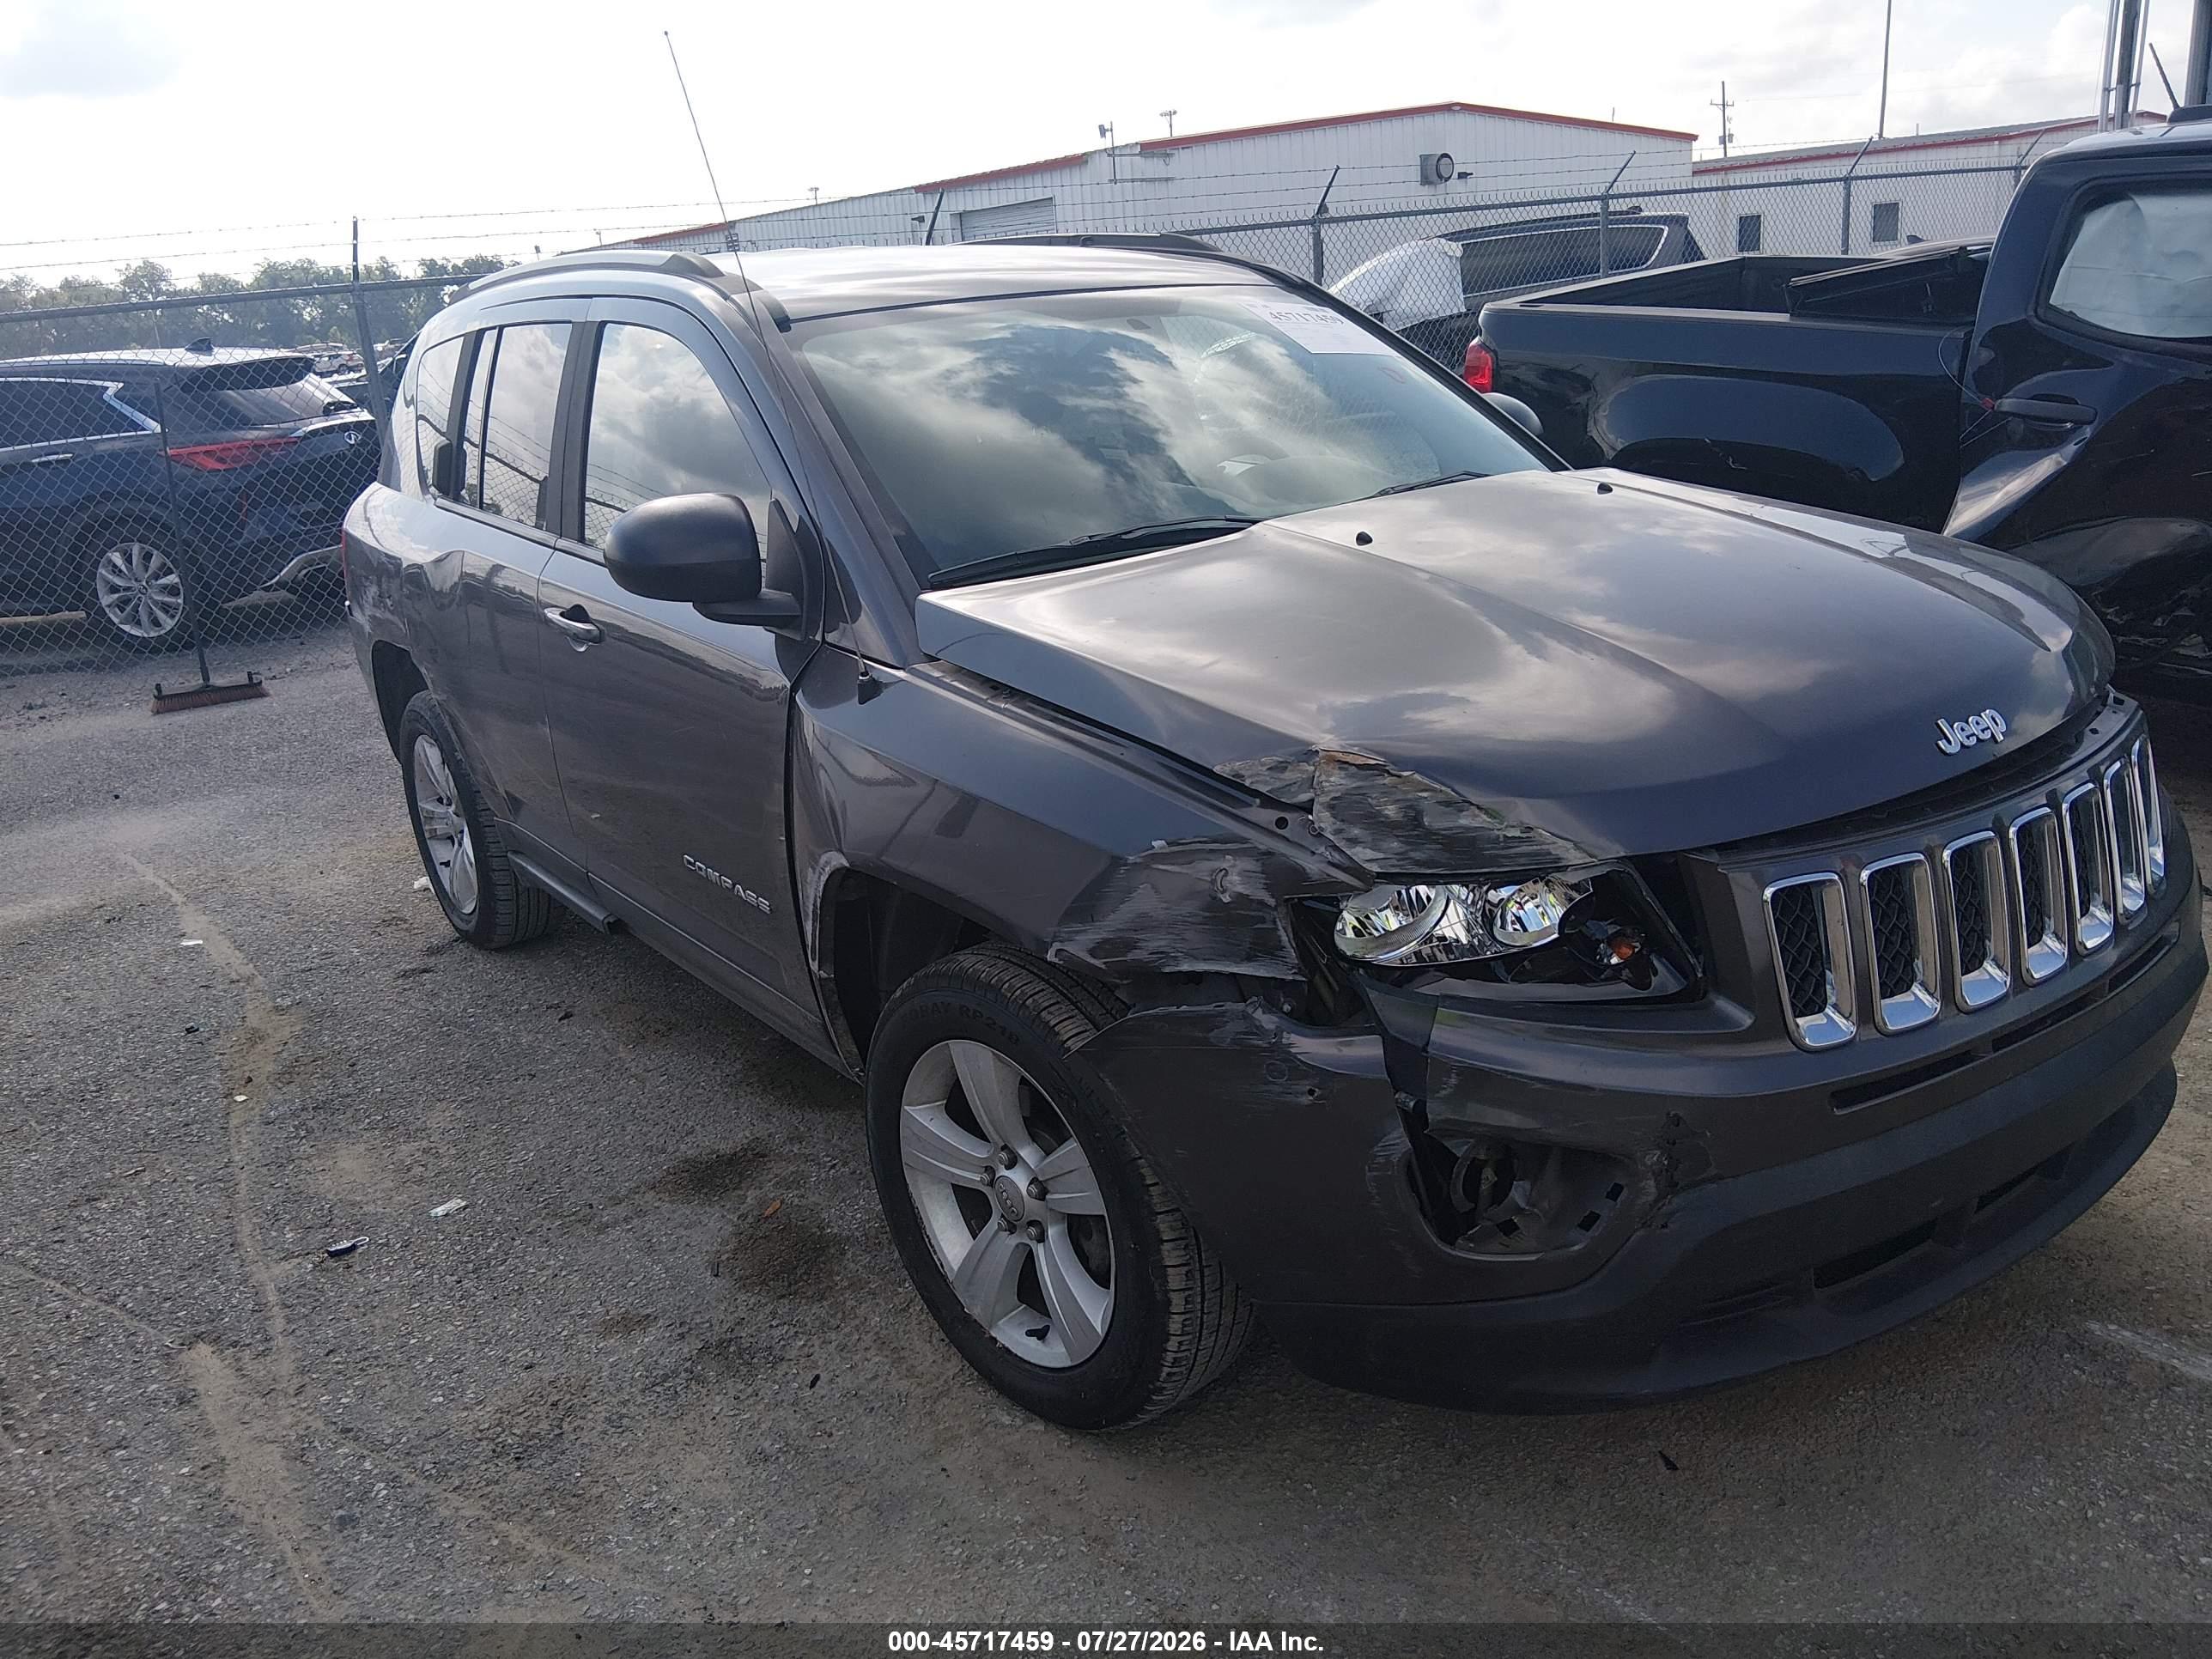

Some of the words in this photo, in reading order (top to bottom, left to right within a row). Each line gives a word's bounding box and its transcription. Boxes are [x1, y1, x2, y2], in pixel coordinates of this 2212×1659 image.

[1269, 311, 1344, 325] 45717459
[1936, 708, 2007, 754] Jeep
[683, 854, 771, 915] COMPASS
